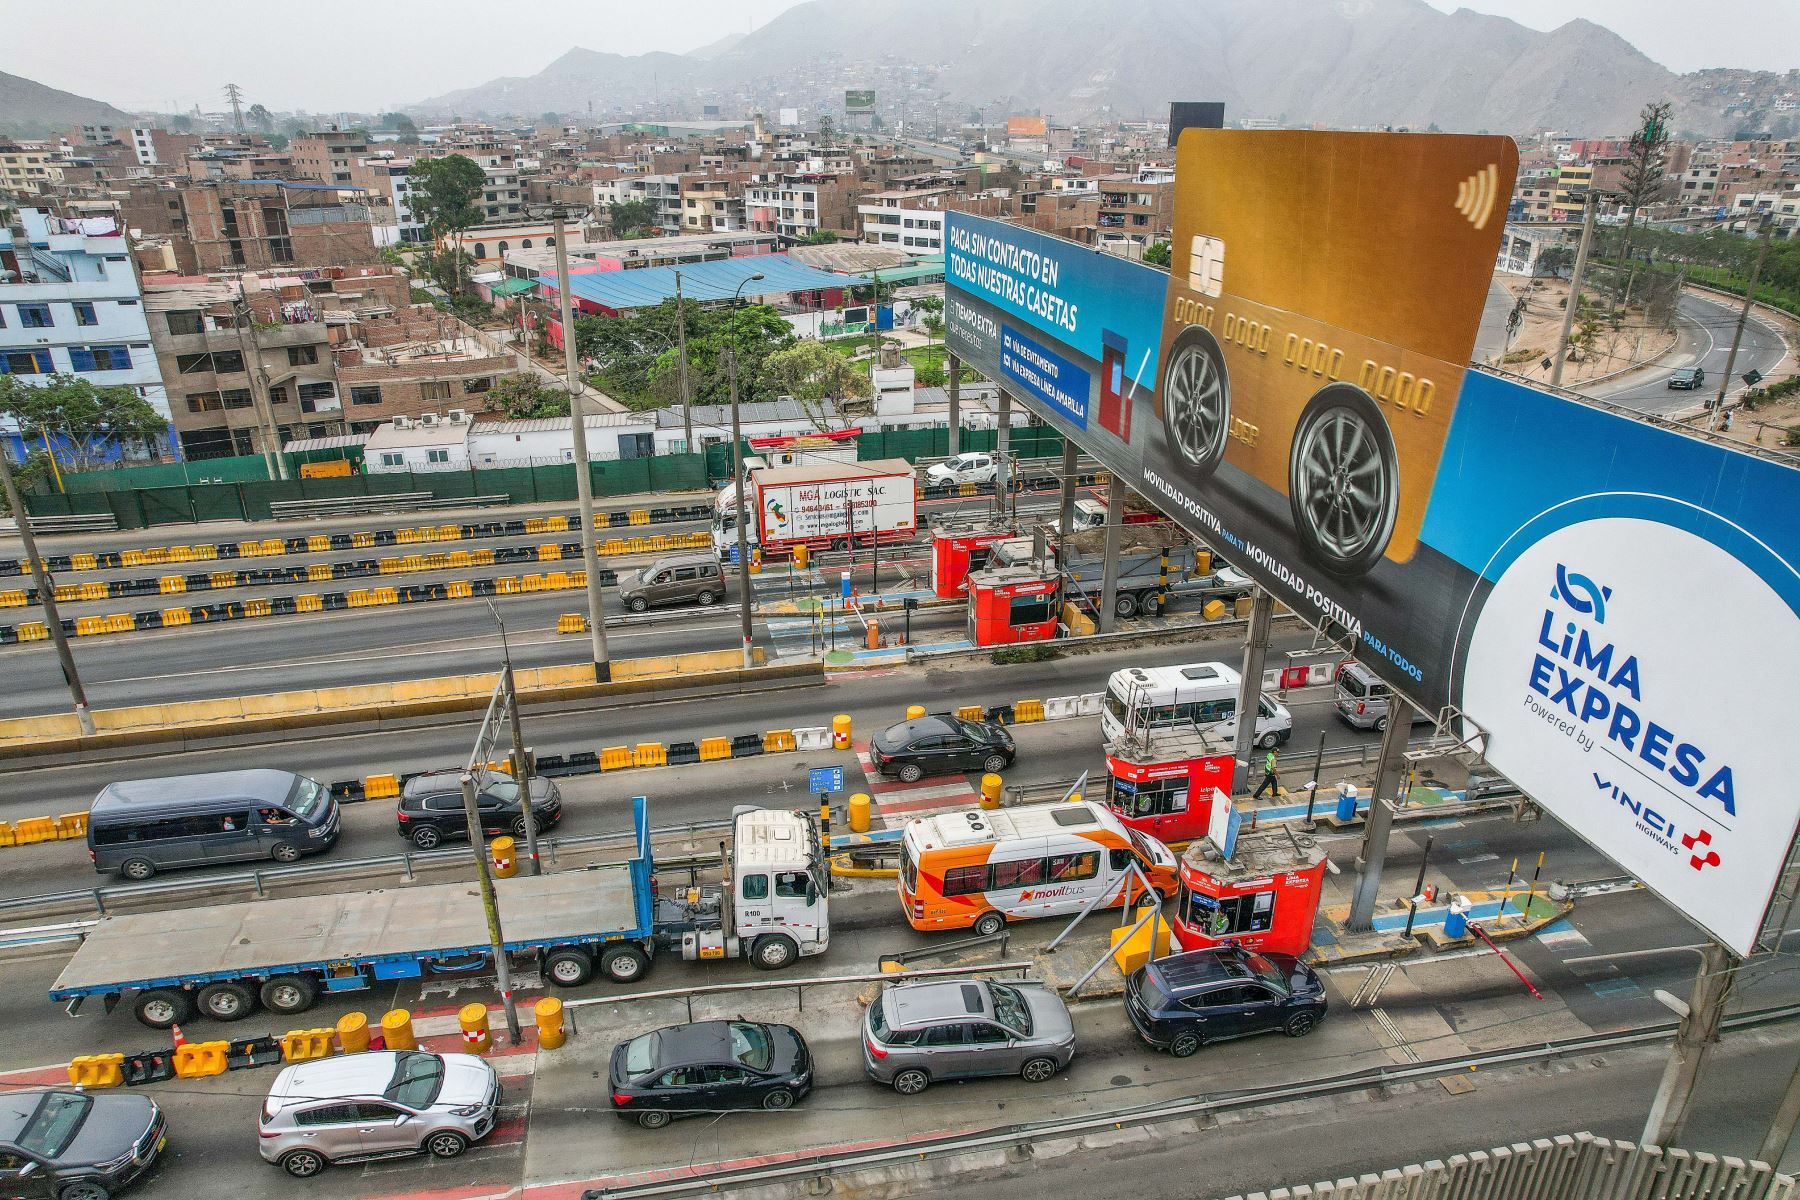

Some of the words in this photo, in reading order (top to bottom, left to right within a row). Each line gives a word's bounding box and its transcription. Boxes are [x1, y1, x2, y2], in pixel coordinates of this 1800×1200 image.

[951, 226, 970, 253] PAGA
[972, 232, 986, 258] SIN
[988, 238, 1040, 279] CONTACTO
[1042, 257, 1058, 288] EN
[950, 253, 976, 283] TODAS
[978, 264, 1026, 306] NUESTRAS
[1026, 286, 1078, 332] CASETAS
[955, 302, 976, 328] TIEMPO
[977, 314, 998, 340] EXTRA
[1020, 366, 1040, 391] EXPRESA
[1055, 391, 1084, 418] AMARILLA
[1026, 348, 1058, 378] EVITAMIENTO
[1223, 312, 1272, 356] 0000
[1284, 332, 1344, 382] 0000
[1359, 359, 1436, 418] 0000
[799, 490, 820, 502] MGA
[824, 488, 862, 500] LOGISTIC
[1144, 467, 1184, 505] MOVILIDAD
[1184, 497, 1222, 535] POSITIVA
[1222, 528, 1238, 546] PARA
[1237, 538, 1244, 550] TI
[1246, 542, 1305, 594] MOVILIDAD
[1306, 584, 1362, 638] POSITIVA
[1364, 631, 1387, 658] PARA
[1389, 649, 1423, 682] TODOS
[1524, 694, 1577, 738] Powered
[1576, 730, 1594, 752] by
[1528, 652, 1736, 817] EXPRESA
[1592, 772, 1675, 838] VINCI
[1635, 820, 1679, 856] HIGHWAYS
